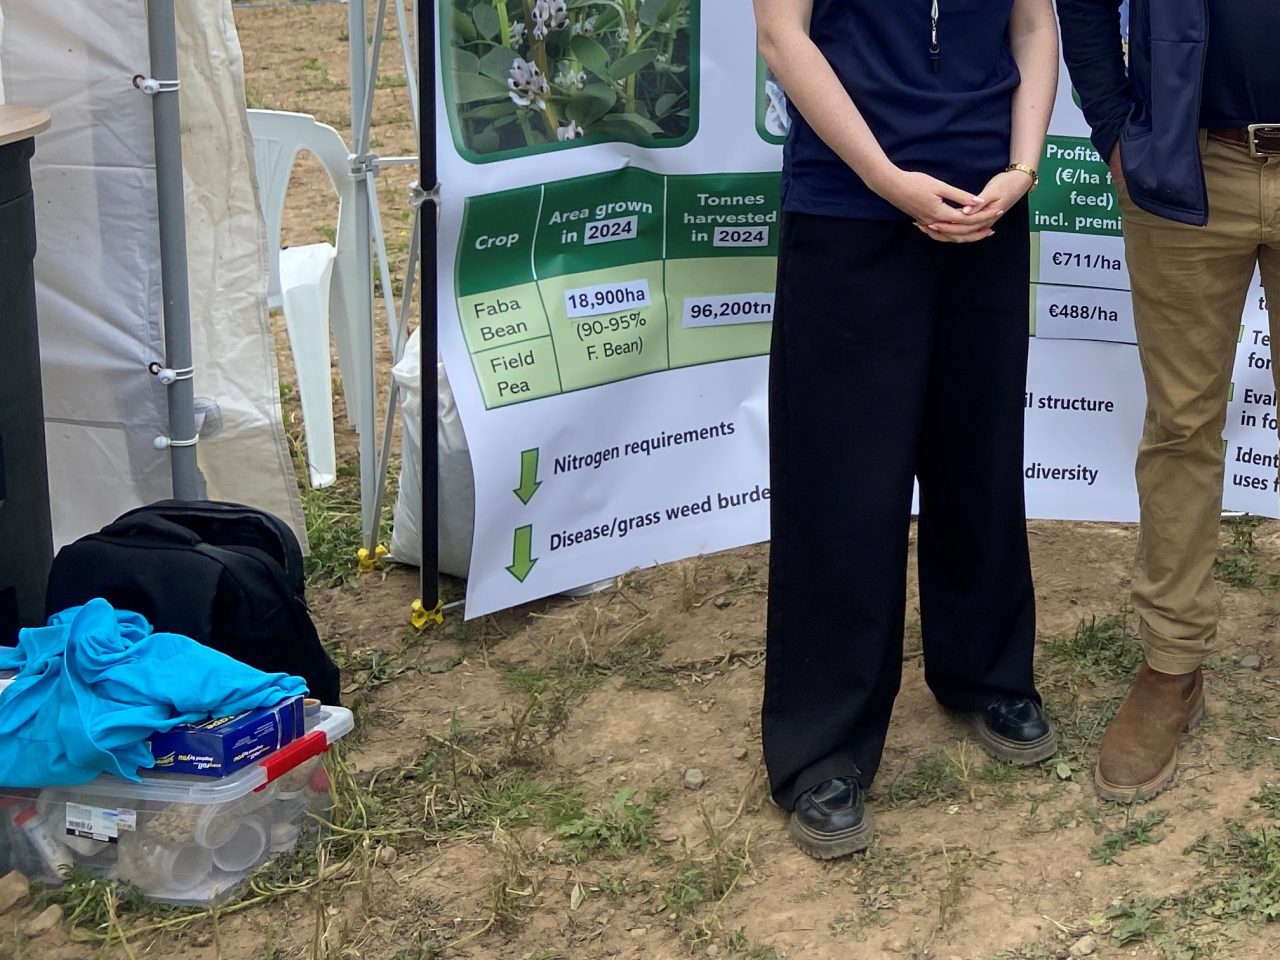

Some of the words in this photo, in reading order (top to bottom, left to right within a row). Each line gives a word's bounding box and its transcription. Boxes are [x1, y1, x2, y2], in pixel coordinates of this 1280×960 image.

[1046, 143, 1105, 162] Profita
[1055, 167, 1100, 185] (€/ha
[697, 193, 765, 206] Tonnes
[1070, 190, 1114, 211] feed)
[549, 209, 590, 226] Area
[594, 199, 653, 220] grown
[683, 209, 777, 225] harvested
[1034, 210, 1069, 226] incl.
[1075, 216, 1122, 231] premi
[474, 232, 519, 250] Crop
[561, 227, 578, 244] in
[588, 221, 633, 239] 2024
[691, 229, 709, 243] in
[717, 228, 764, 244] 2024
[1052, 252, 1121, 271] €711/ha
[474, 297, 521, 320] Faba
[568, 286, 646, 311] 18,900ha
[690, 300, 772, 321] 96,200tn
[1049, 303, 1118, 322] €488/ha
[481, 319, 528, 341] Bean
[576, 311, 647, 342] (90-95%
[587, 344, 600, 361] F.
[603, 336, 644, 360] Bean)
[490, 350, 535, 372] Field
[497, 379, 530, 397] Pea
[1038, 394, 1115, 412] structure
[1240, 410, 1257, 427] in
[553, 446, 620, 475] Nitrogen
[624, 421, 736, 456] requirements
[1024, 462, 1099, 485] diversity
[1232, 473, 1268, 491] uses
[550, 511, 661, 551] Disease/grass
[665, 495, 713, 520] weed
